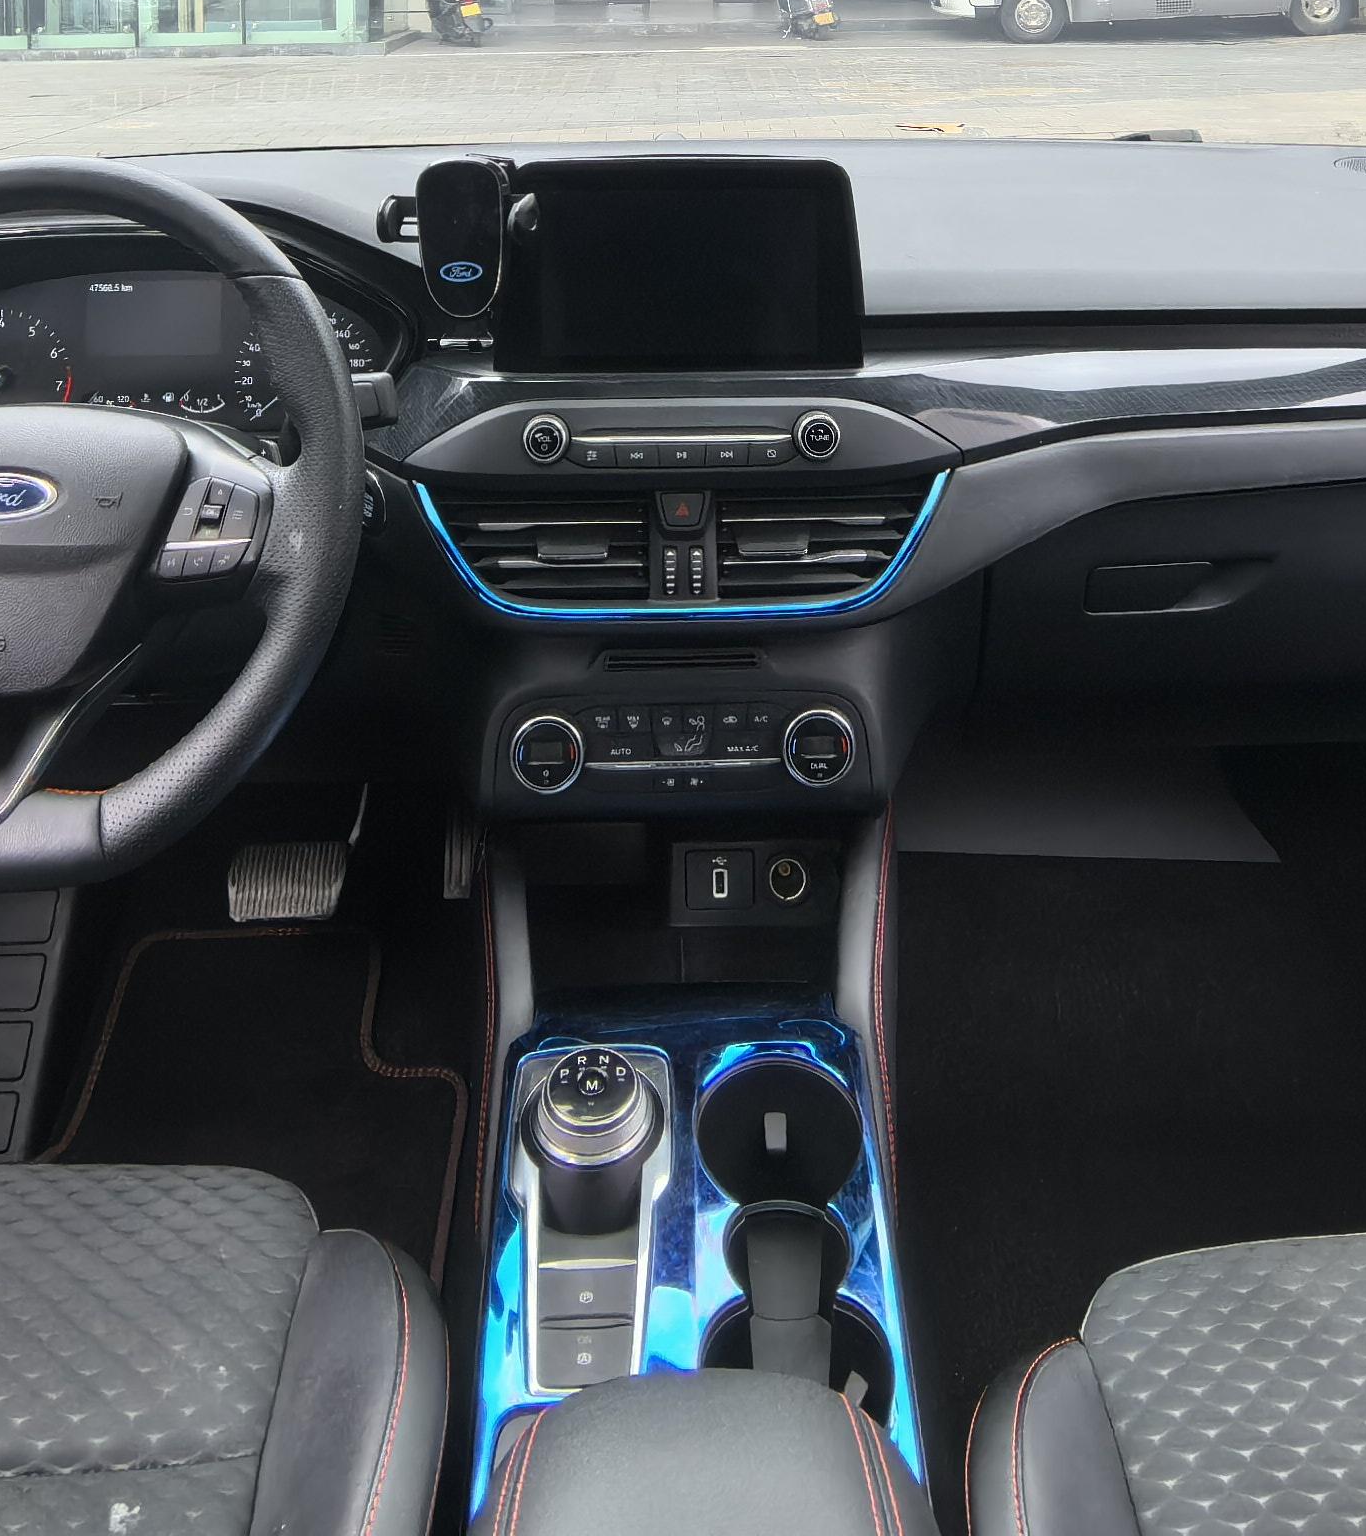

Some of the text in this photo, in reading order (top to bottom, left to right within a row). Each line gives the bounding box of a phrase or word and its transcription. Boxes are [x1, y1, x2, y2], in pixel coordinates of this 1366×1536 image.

[28, 326, 36, 337] 5
[335, 330, 350, 338] 140
[248, 344, 261, 352] 40
[50, 348, 58, 359] 6
[349, 359, 365, 367] 180
[55, 381, 63, 392] 7
[117, 395, 130, 403] 120
[197, 398, 208, 406] 1/2
[577, 1055, 609, 1065] R N
[560, 1067, 626, 1079] P D
[586, 1080, 598, 1090] M
